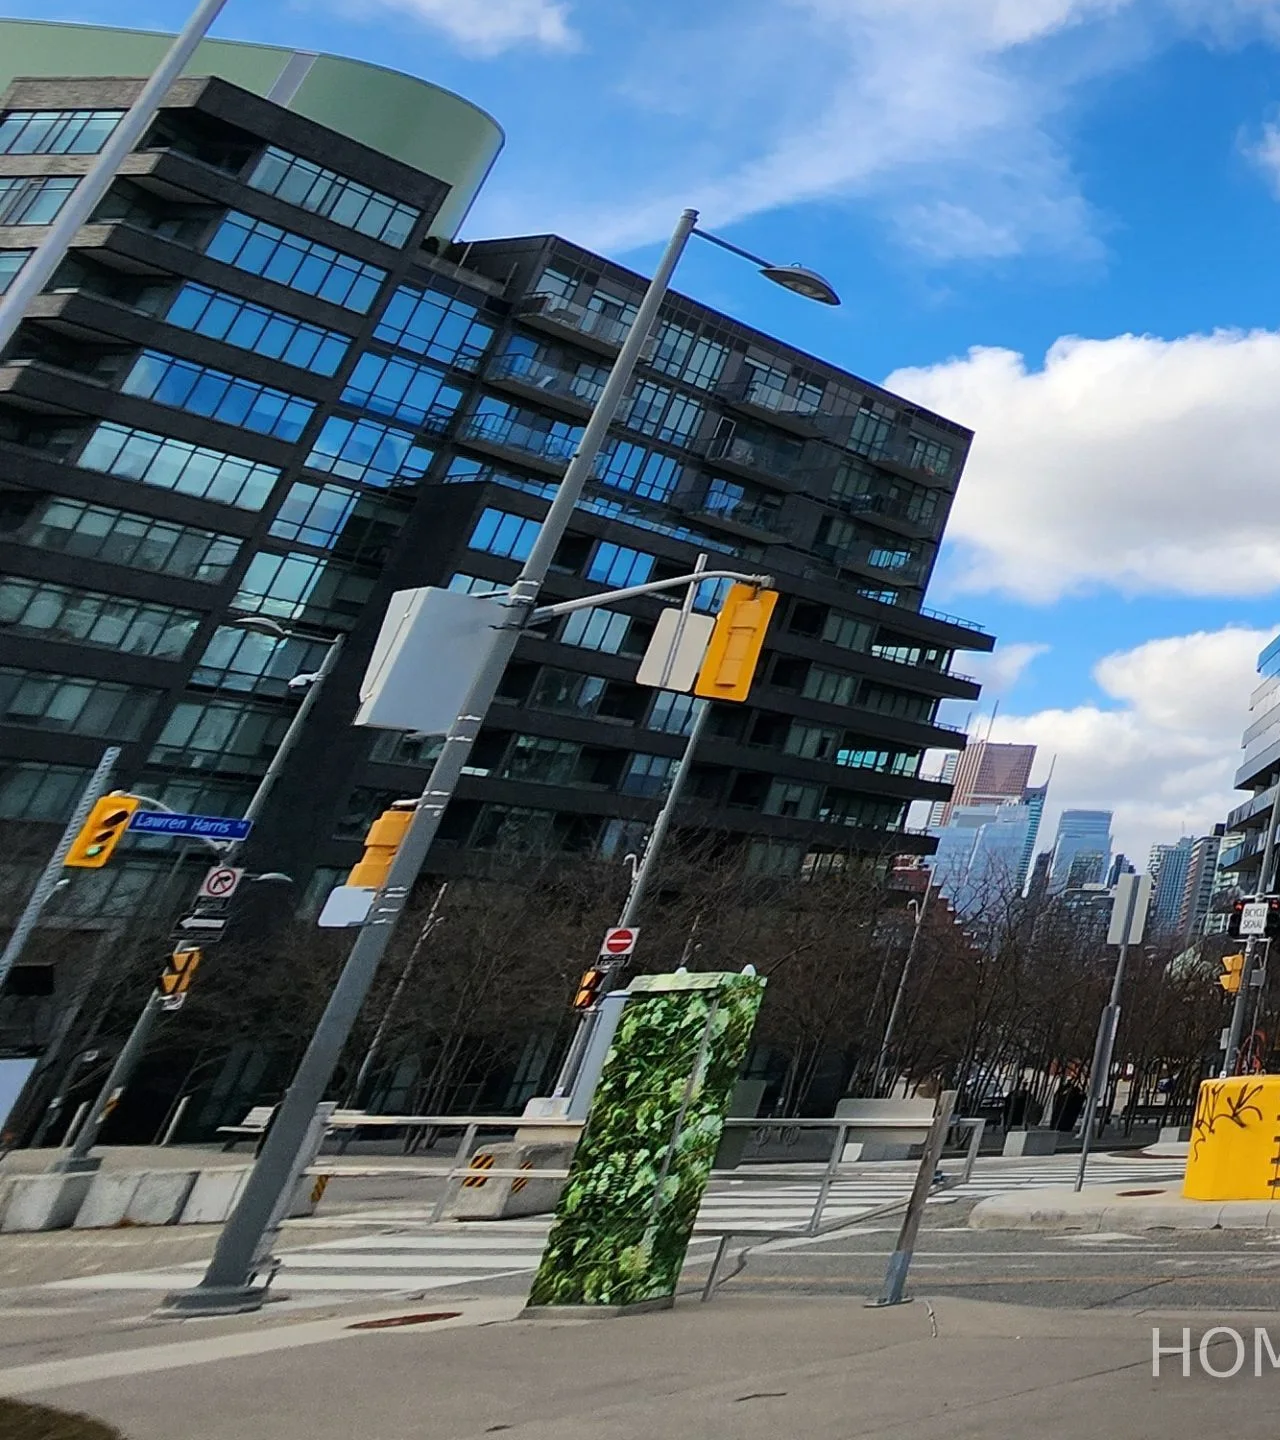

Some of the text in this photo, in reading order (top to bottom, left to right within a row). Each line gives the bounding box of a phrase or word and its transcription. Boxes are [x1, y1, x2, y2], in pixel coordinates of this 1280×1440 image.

[135, 814, 187, 830] Lawren
[190, 818, 230, 834] Harris
[1244, 908, 1266, 917] BICYCLE
[1242, 920, 1263, 929] SIGNAL
